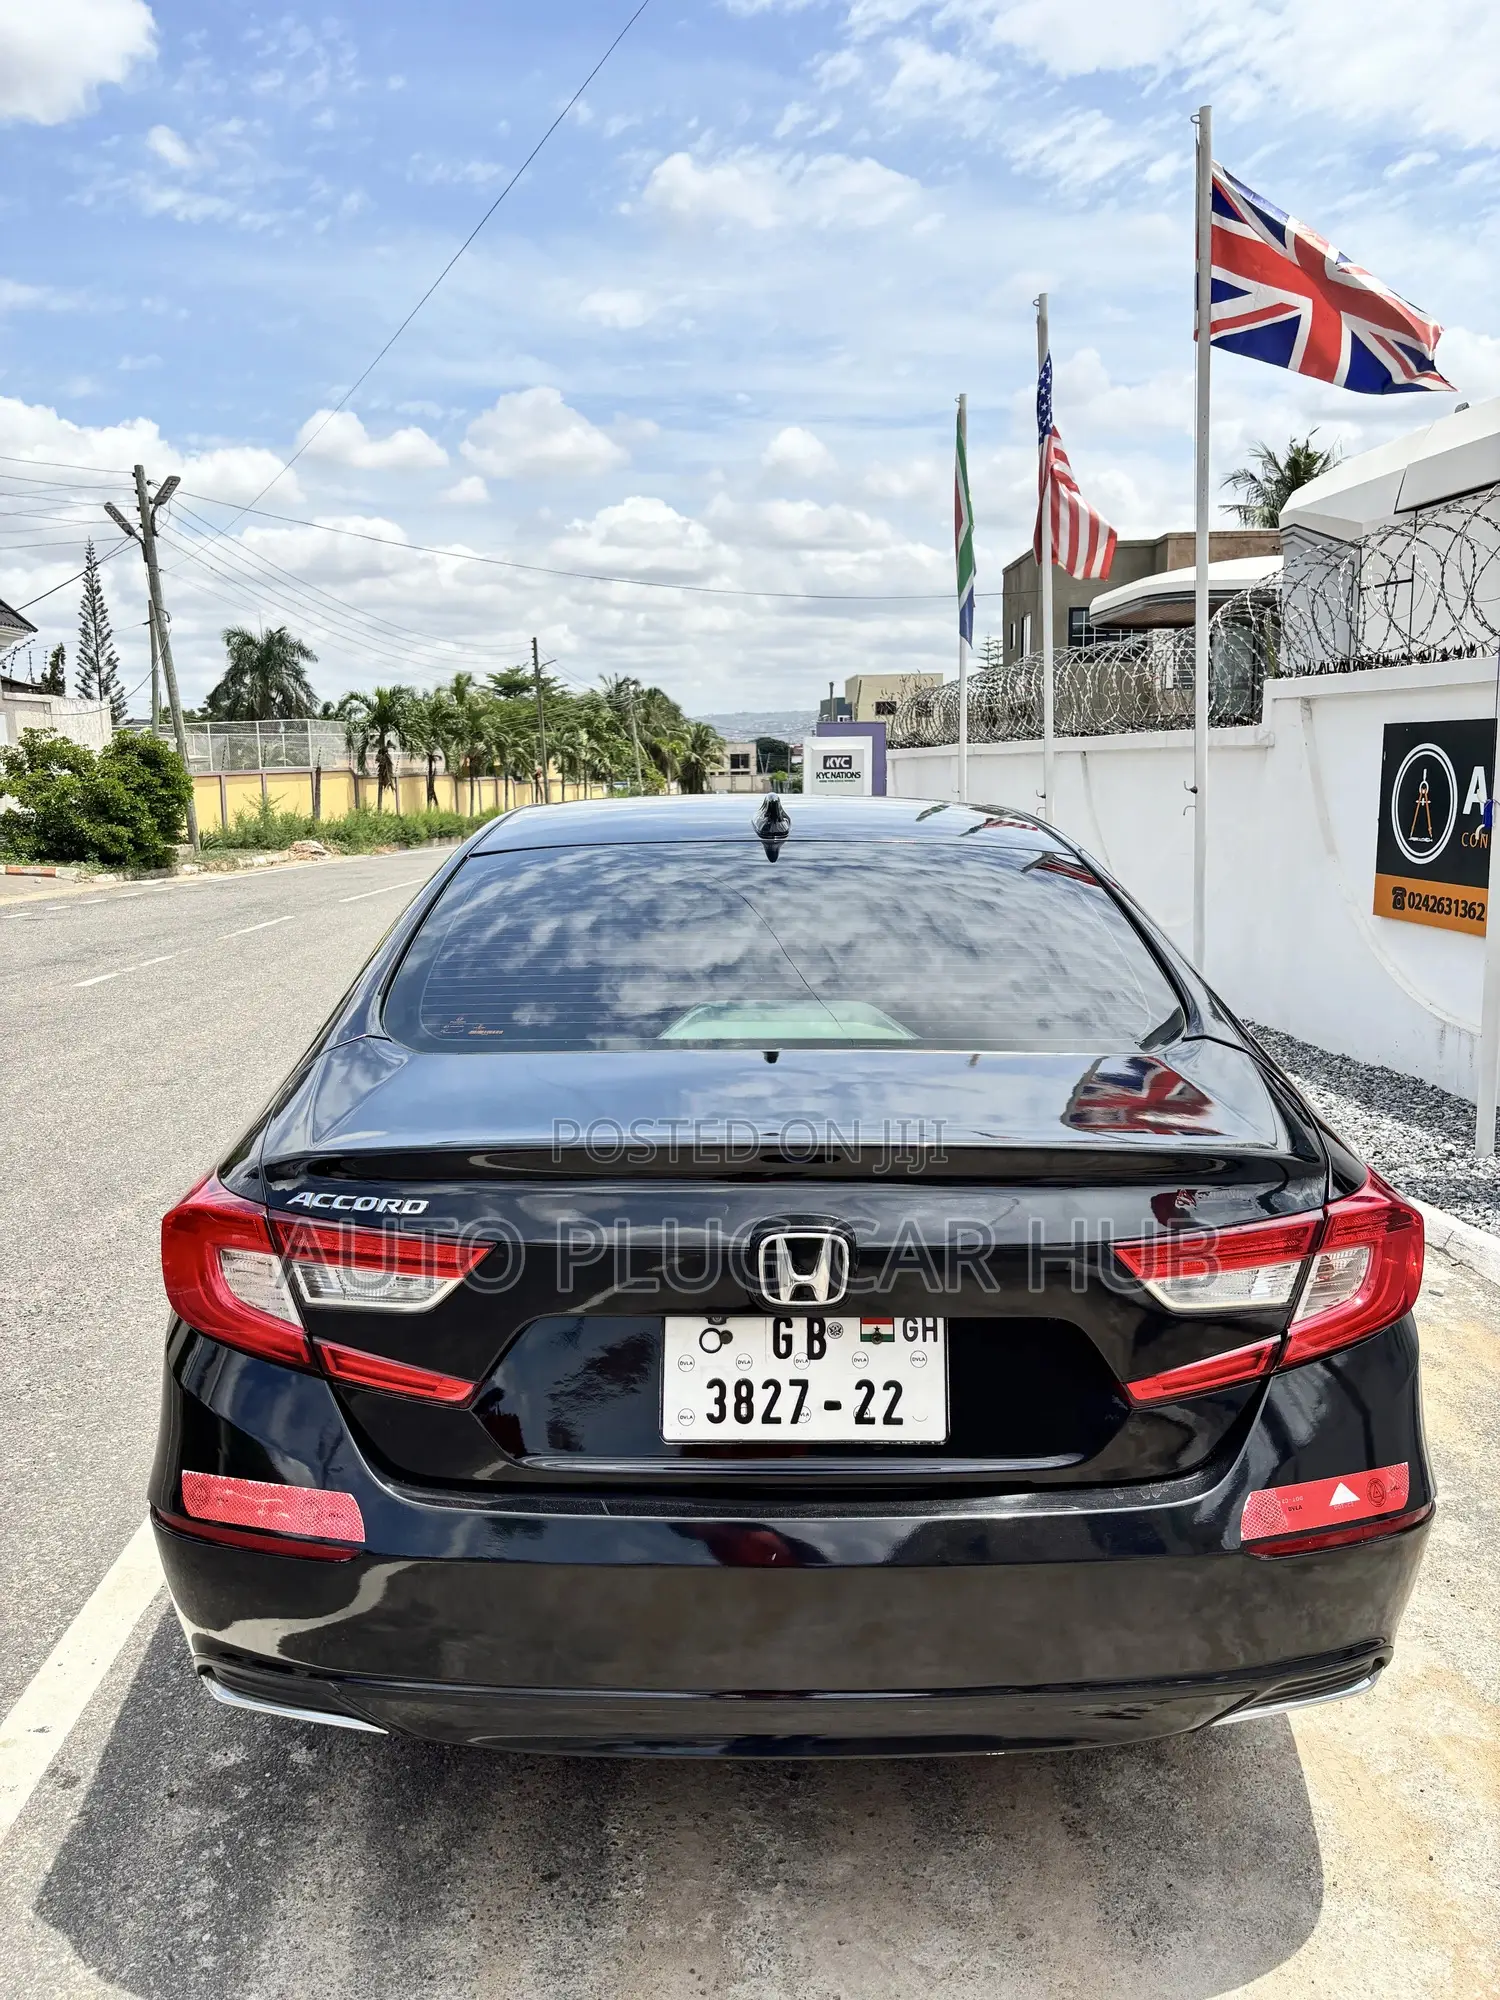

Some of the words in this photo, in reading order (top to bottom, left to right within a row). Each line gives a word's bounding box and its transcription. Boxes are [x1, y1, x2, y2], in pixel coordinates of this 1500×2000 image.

[826, 757, 850, 767] KYC
[830, 771, 861, 779] NATIONS
[1407, 891, 1486, 922] 0242631362
[286, 1192, 430, 1215] ACCORD
[773, 1317, 827, 1360] GB
[902, 1317, 938, 1343] GH
